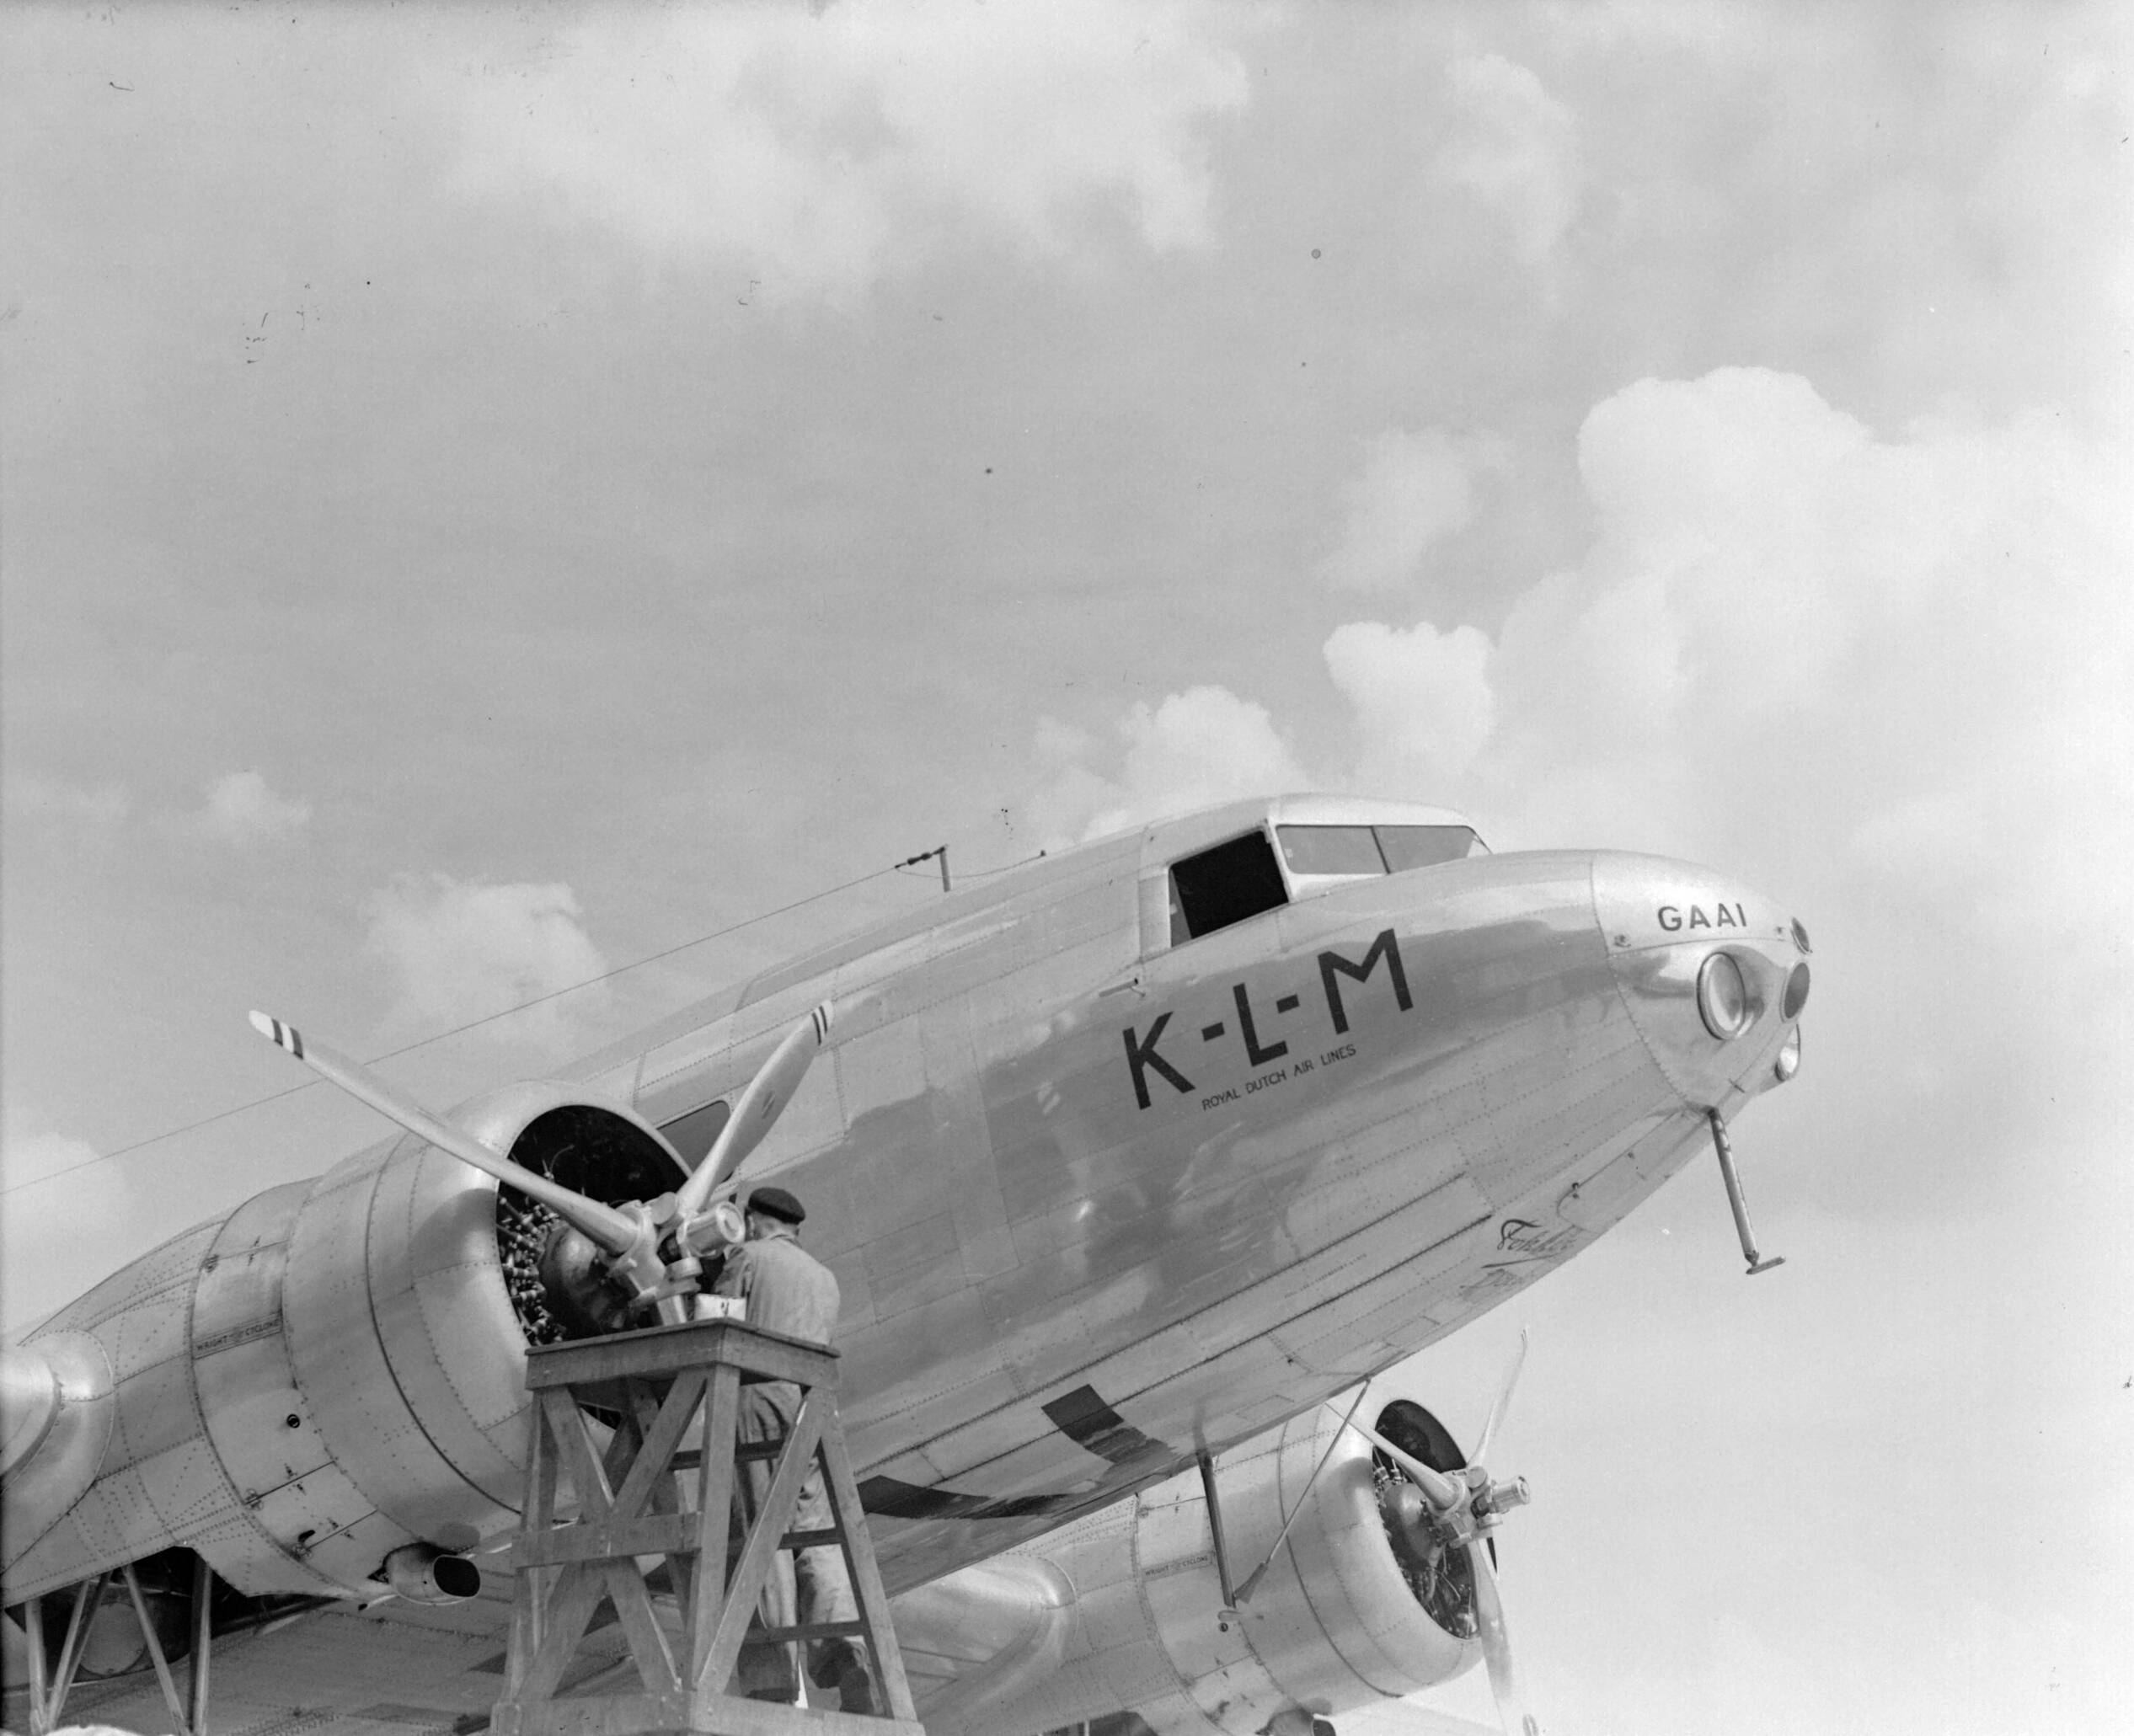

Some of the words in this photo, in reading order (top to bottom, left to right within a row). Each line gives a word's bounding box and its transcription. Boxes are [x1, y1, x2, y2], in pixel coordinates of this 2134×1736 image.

[1657, 906, 1747, 932] GAAI
[1122, 927, 1414, 1110] K-L-M
[1201, 1088, 1241, 1112] ROYAL
[1245, 1069, 1287, 1094] DUTCH
[1293, 1060, 1314, 1077] AIR
[1320, 1044, 1357, 1066] LINES
